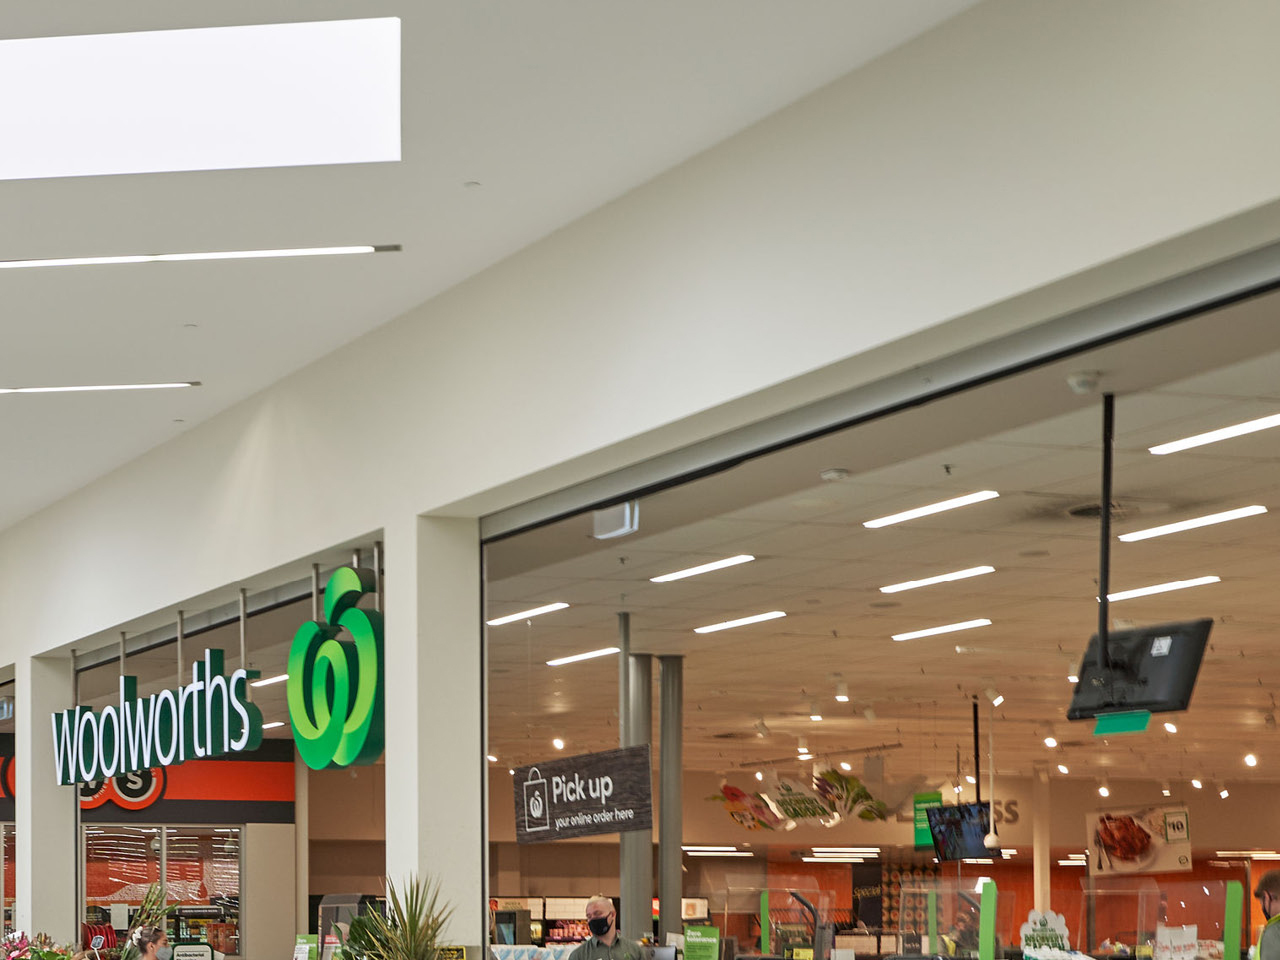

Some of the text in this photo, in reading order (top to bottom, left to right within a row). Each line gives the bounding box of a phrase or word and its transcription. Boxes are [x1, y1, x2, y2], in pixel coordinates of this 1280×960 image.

[51, 648, 250, 785] woolworths
[552, 773, 613, 805] Pick up
[555, 808, 635, 831] your online order here
